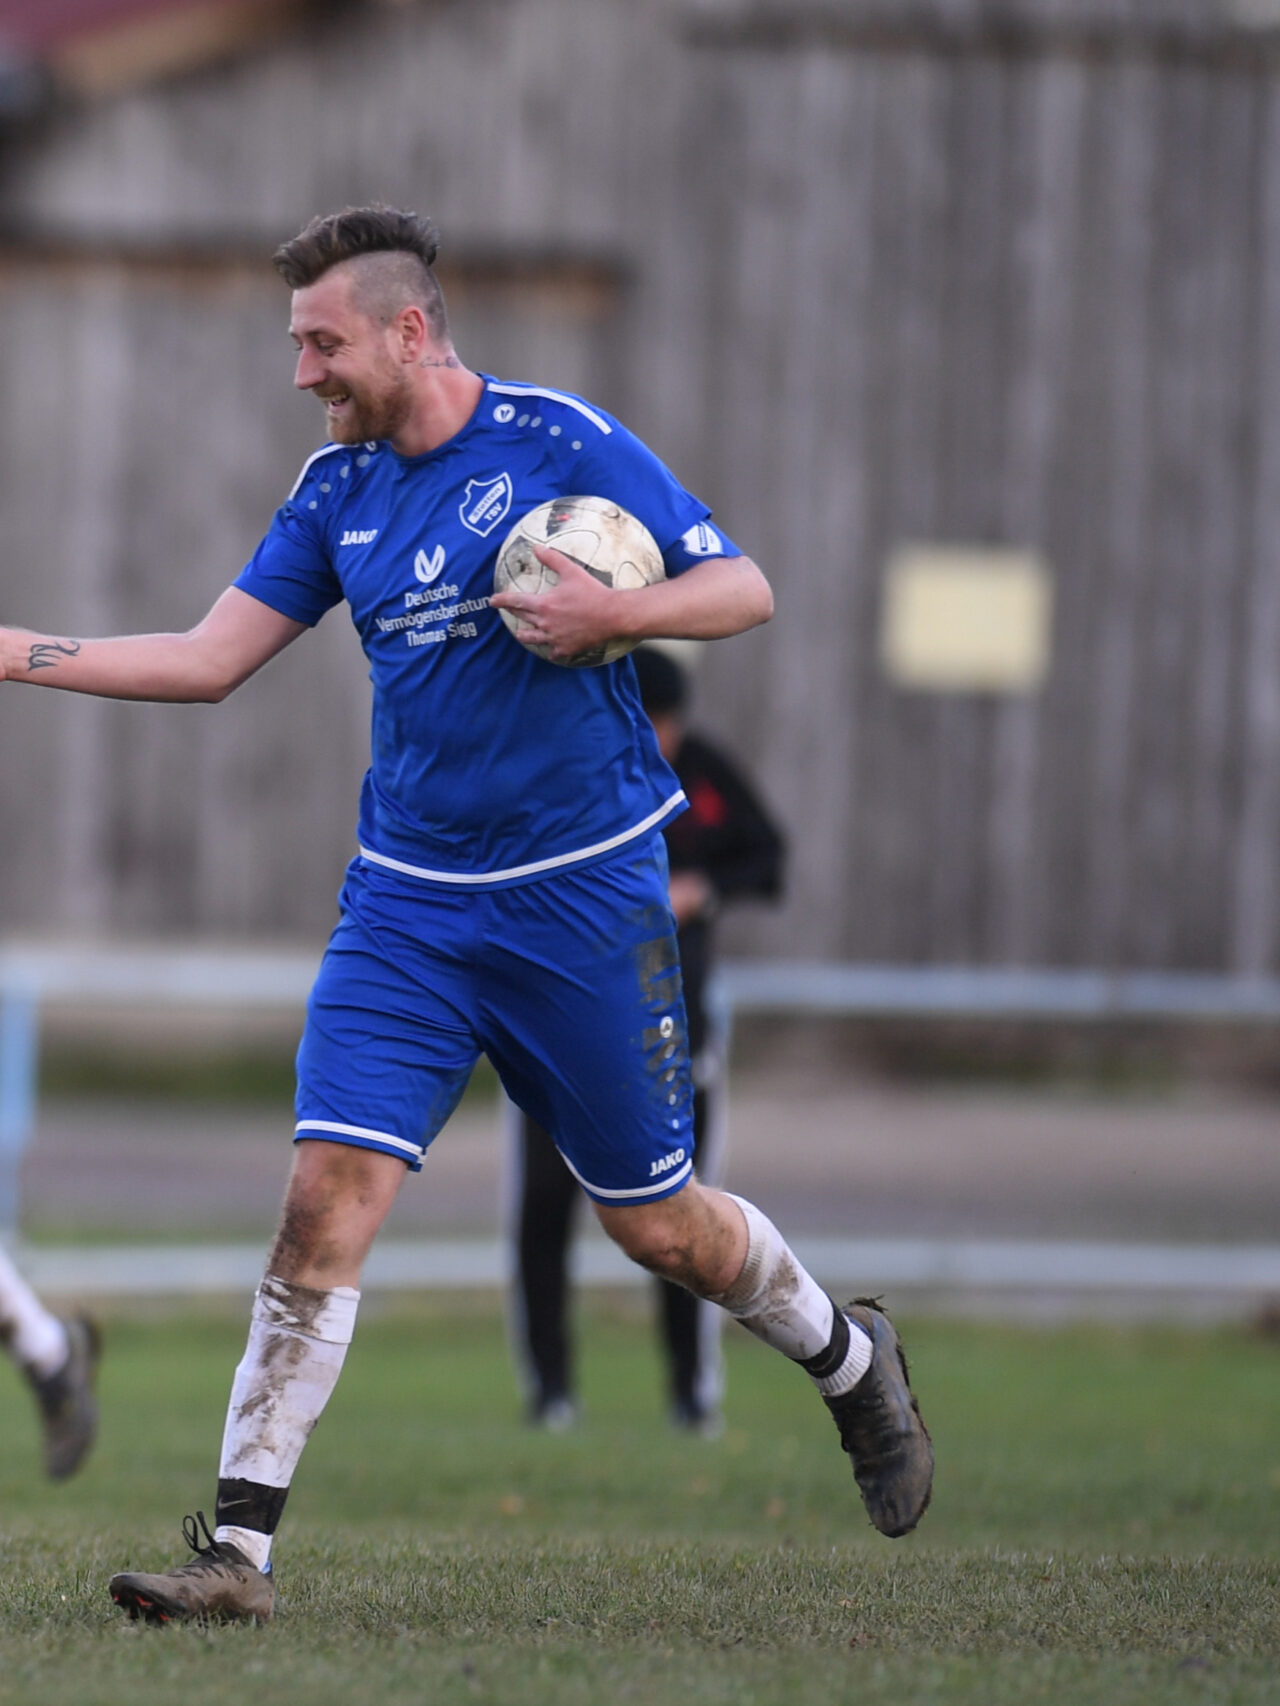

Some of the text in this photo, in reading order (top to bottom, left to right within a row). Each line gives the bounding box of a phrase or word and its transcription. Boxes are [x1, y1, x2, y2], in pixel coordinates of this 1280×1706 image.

[483, 501, 503, 521] TSV
[340, 529, 379, 546] JAKO
[404, 582, 460, 608] Deutsche
[375, 596, 491, 632] Vermögensberatun
[405, 621, 478, 647] Thomas Sigg
[649, 1147, 685, 1177] JAKO
